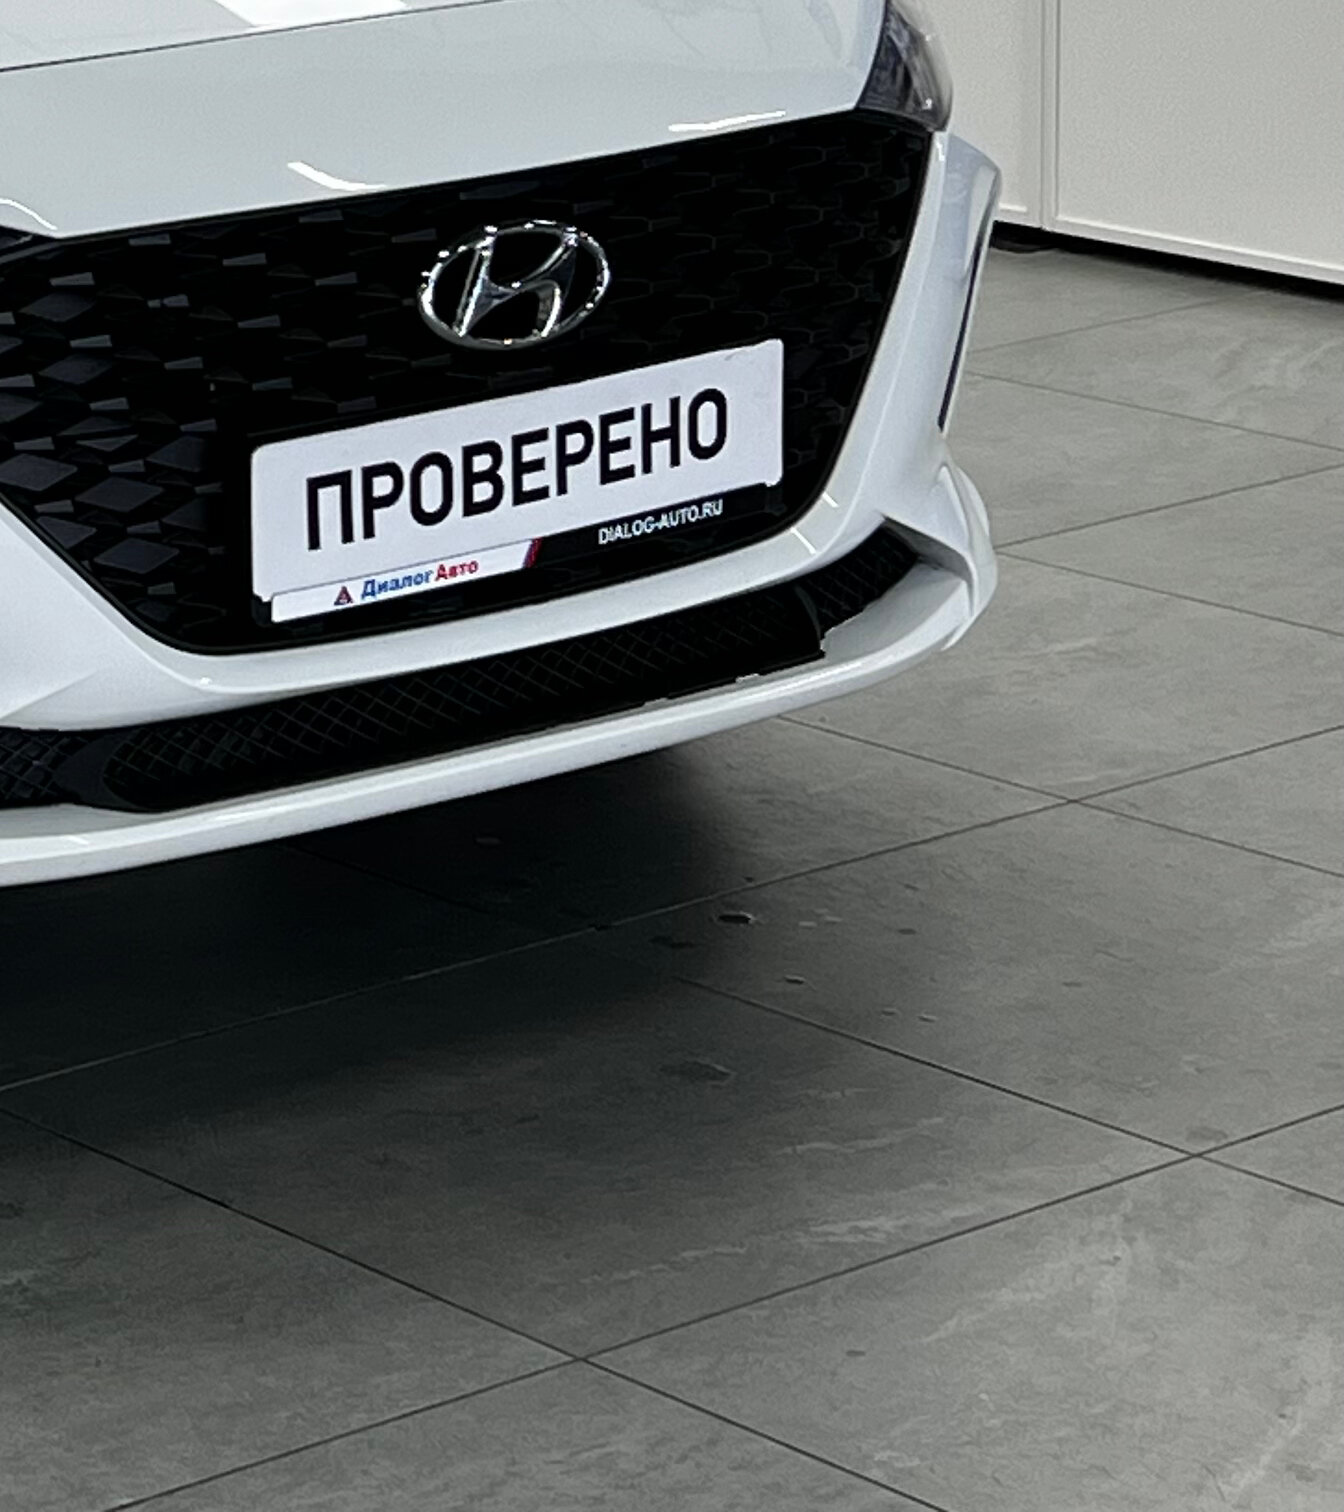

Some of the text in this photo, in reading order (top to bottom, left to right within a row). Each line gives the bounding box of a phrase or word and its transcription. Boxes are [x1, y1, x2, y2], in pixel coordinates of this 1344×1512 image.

[306, 388, 729, 551] ПРОВЕРЕНО
[598, 499, 723, 545] DIALOG-AUTO.RU
[361, 560, 479, 600] Диалог Авто
